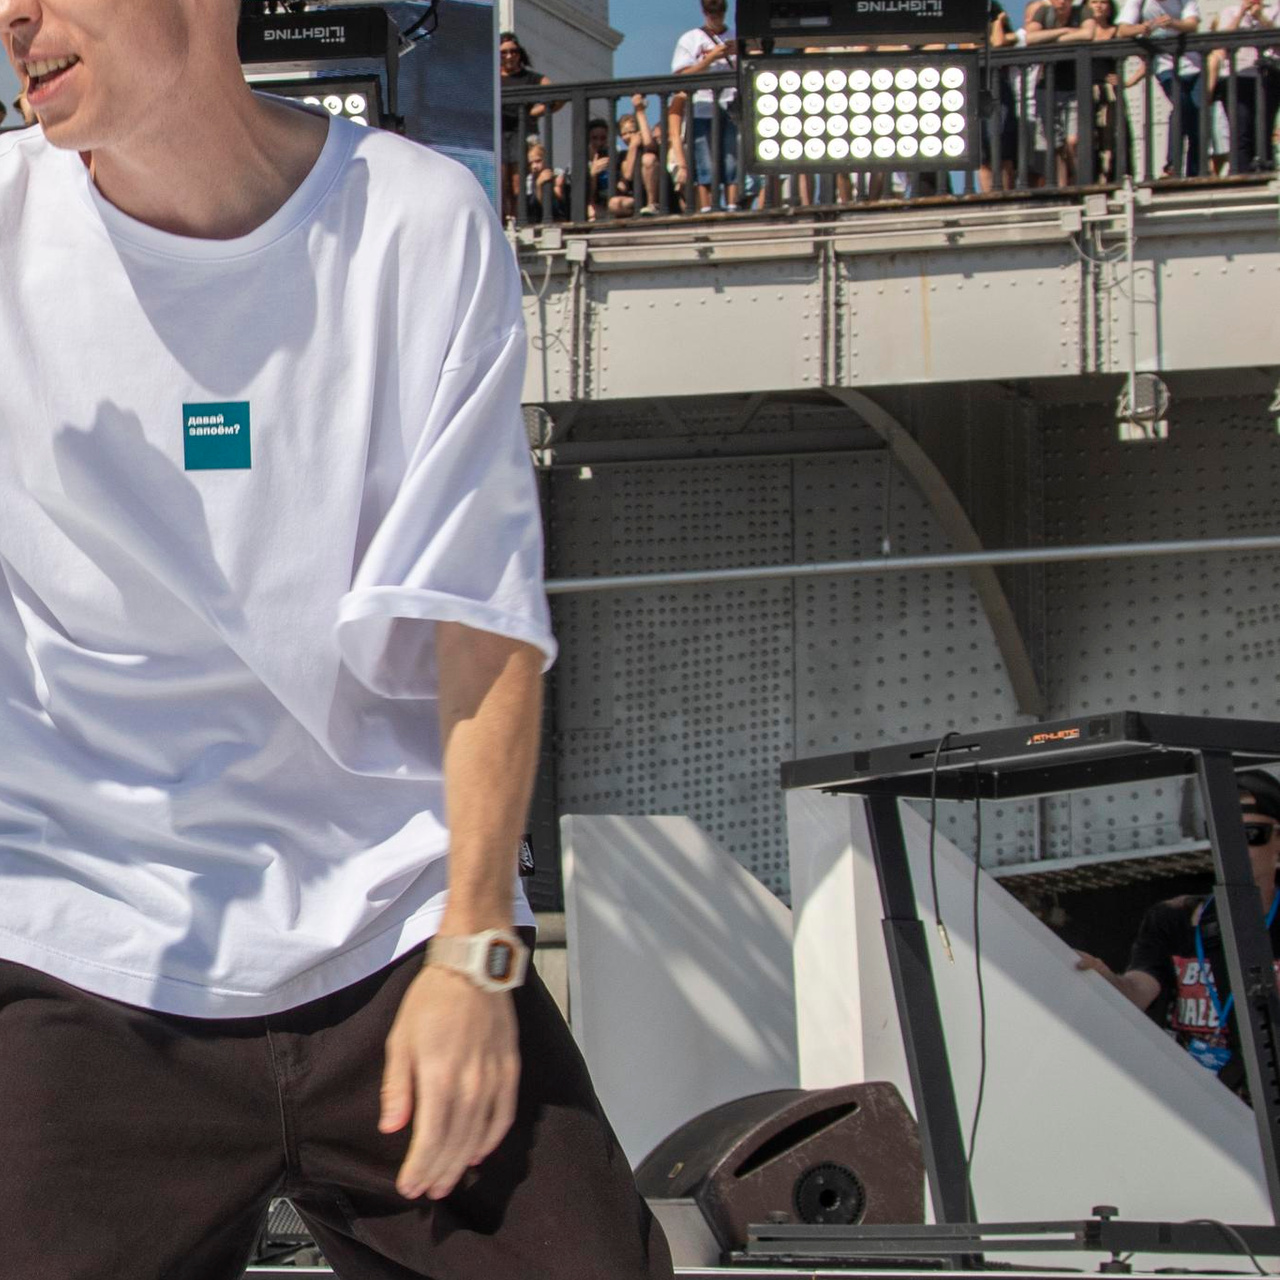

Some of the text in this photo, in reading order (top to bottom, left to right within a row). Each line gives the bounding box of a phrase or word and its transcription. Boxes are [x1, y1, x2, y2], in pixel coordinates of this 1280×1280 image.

[856, 0, 943, 17] iLIGHTING
[264, 26, 346, 44] iLIGHTING
[188, 413, 224, 426] давай
